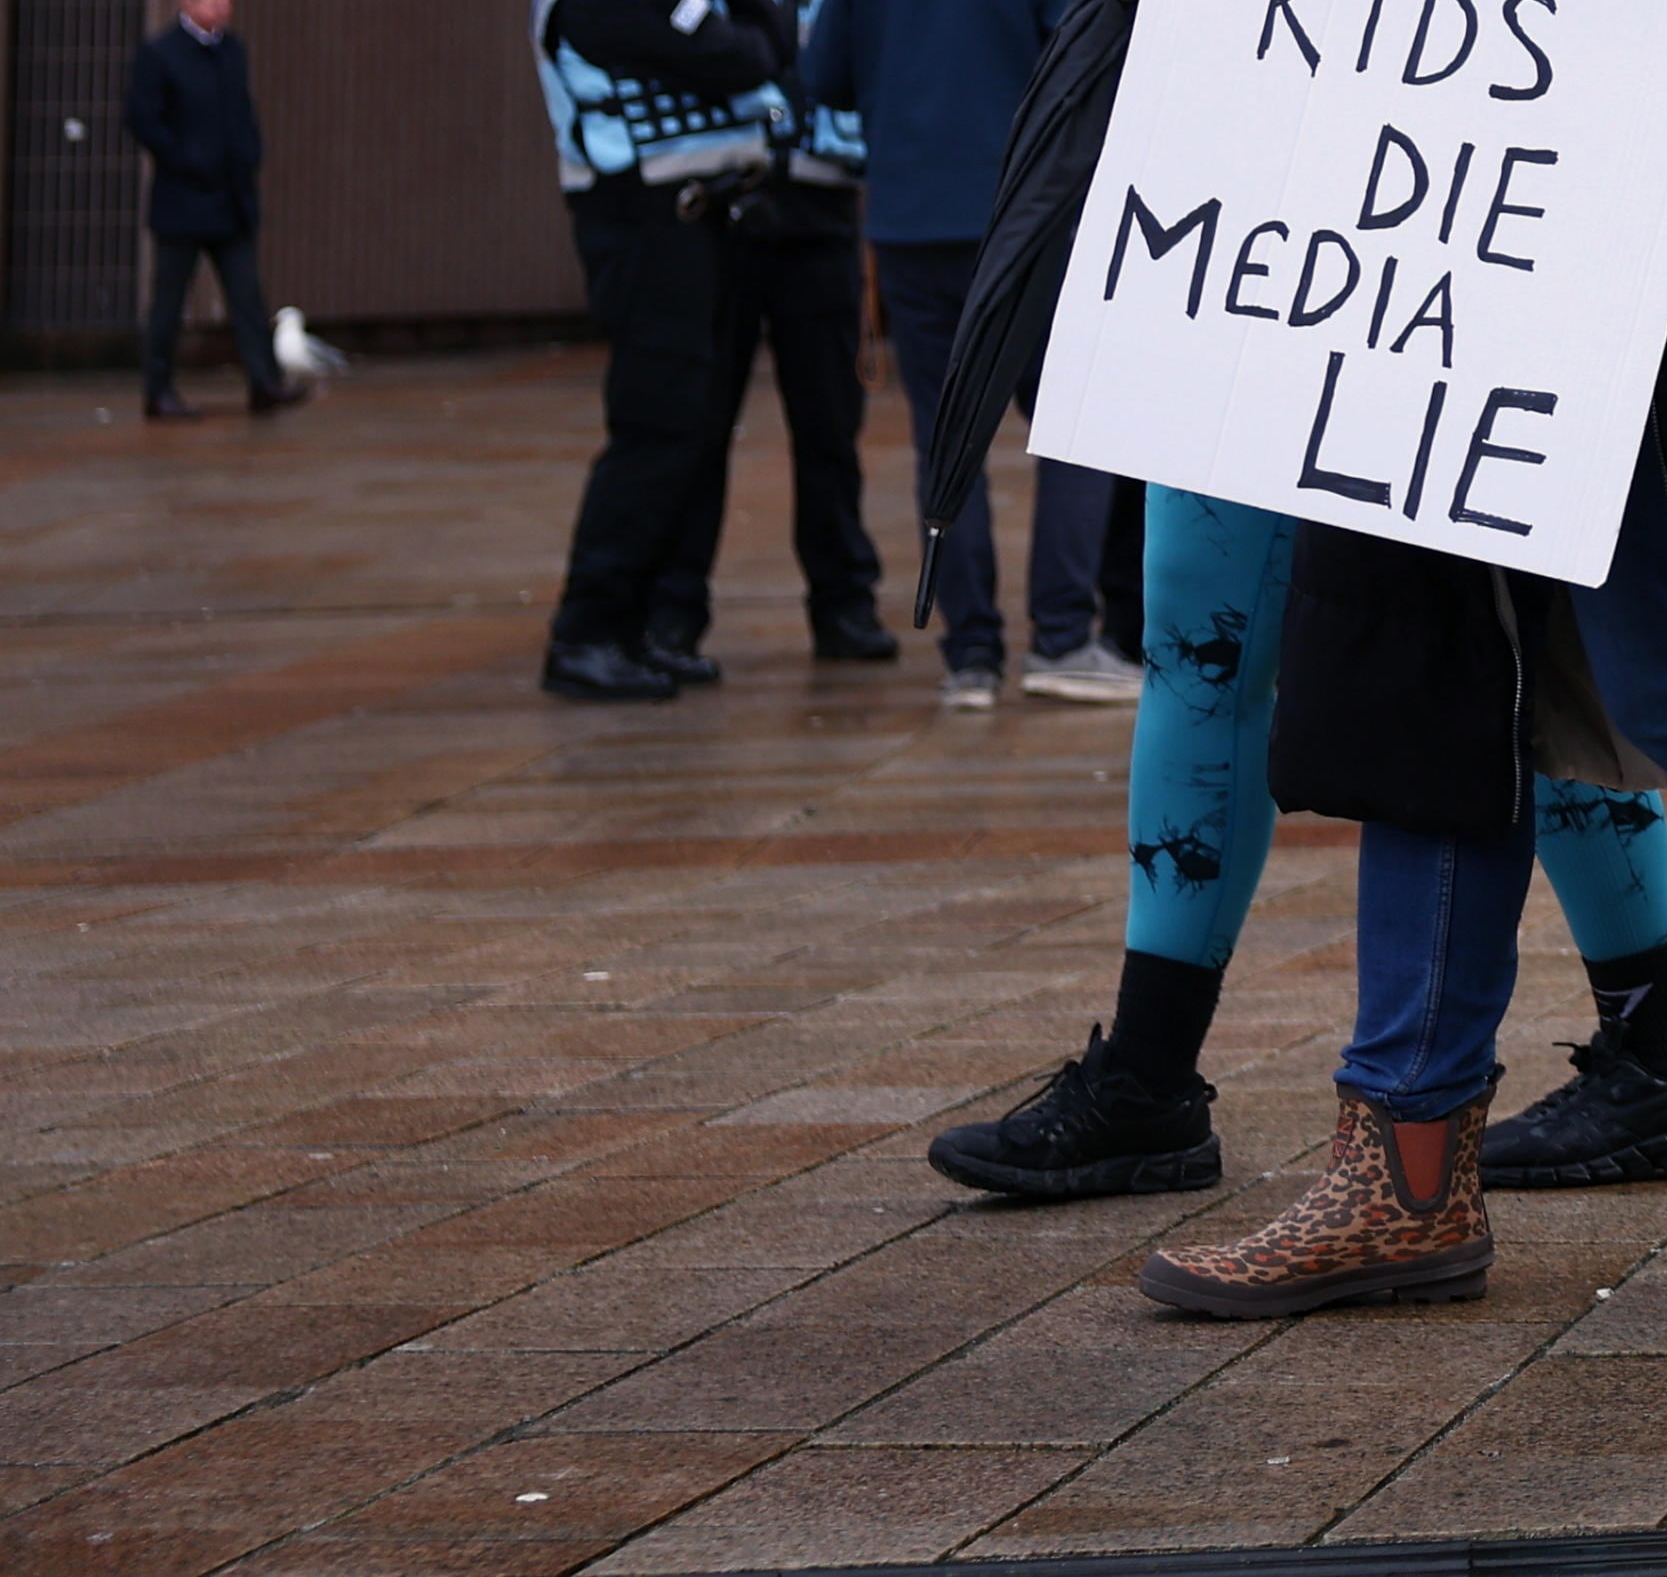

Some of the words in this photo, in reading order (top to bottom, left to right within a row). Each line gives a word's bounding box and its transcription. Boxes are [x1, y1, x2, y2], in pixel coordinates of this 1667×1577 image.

[1103, 184, 1455, 369] MEDIA
[1355, 123, 1559, 272] DIE
[1296, 350, 1559, 537] LIE
